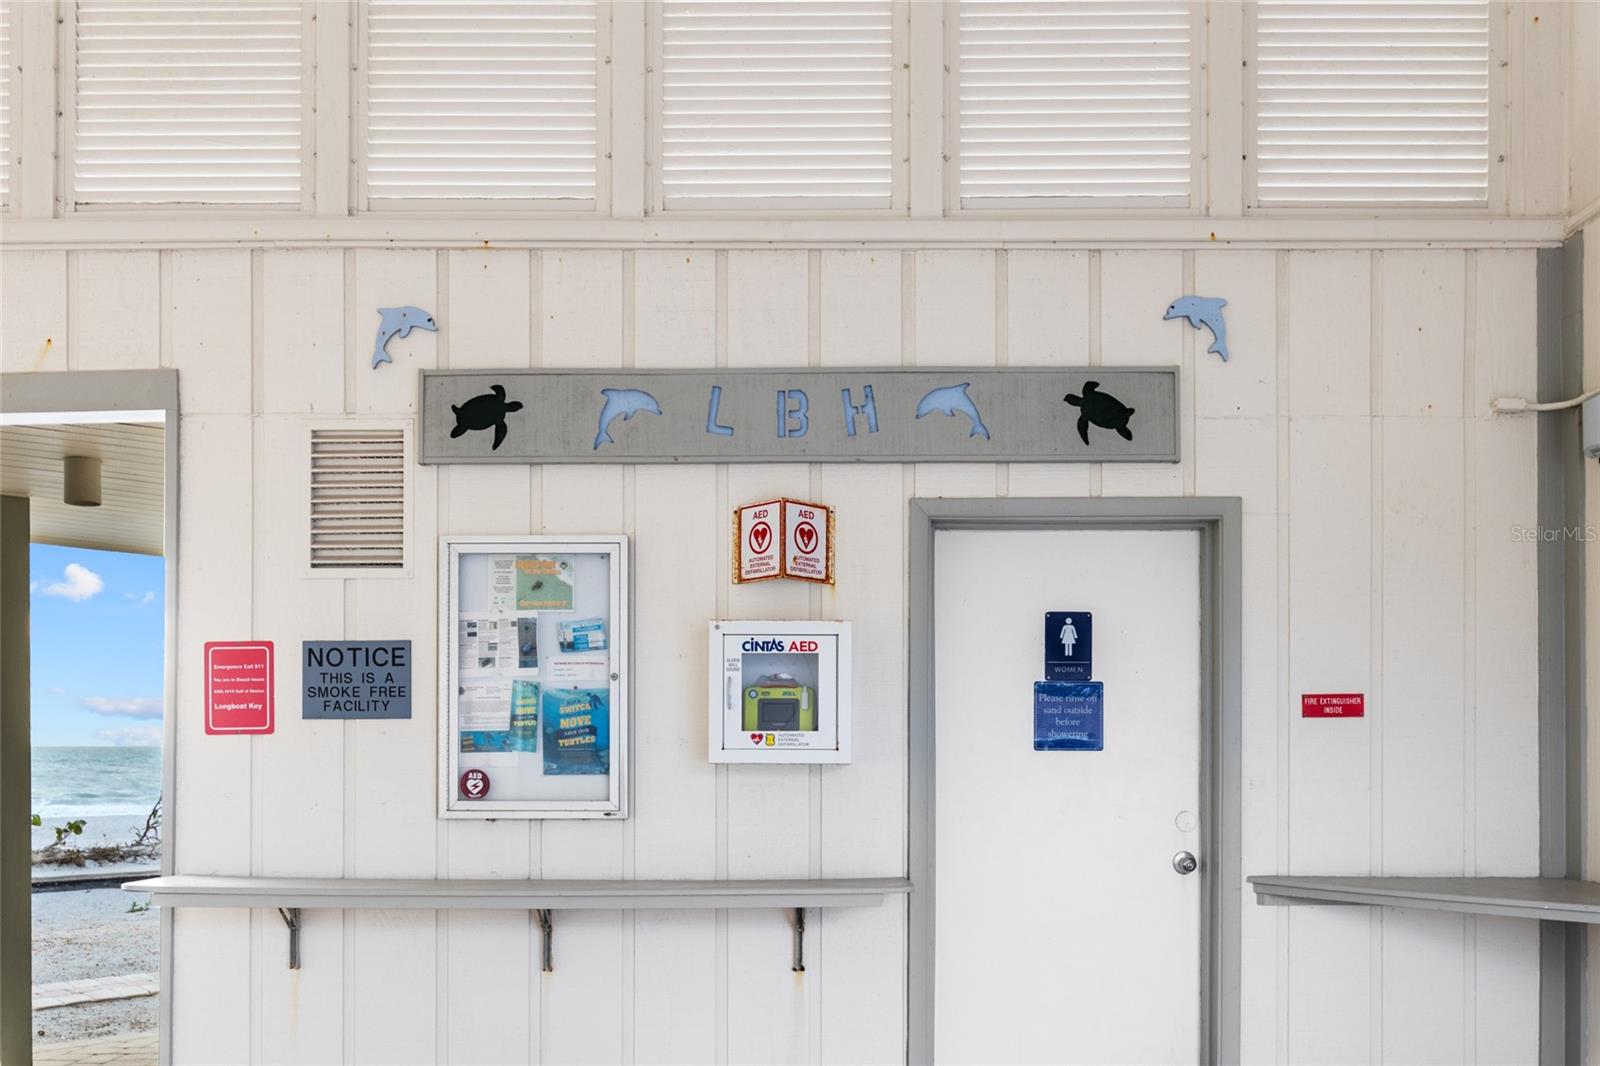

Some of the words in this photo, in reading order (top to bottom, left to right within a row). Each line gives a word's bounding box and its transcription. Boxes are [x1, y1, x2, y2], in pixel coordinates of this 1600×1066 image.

[752, 509, 768, 520] AED
[798, 509, 815, 520] AED
[748, 554, 774, 563] AUTOMATED
[744, 566, 776, 576] DEFIBRILLATOR
[790, 566, 822, 576] DEFIBRILLATOR
[788, 641, 818, 652] AED
[308, 647, 406, 668] NOTICE
[320, 672, 353, 684] THIS
[362, 672, 375, 684] IS
[384, 672, 394, 684] A
[308, 686, 360, 698] SMOKE
[370, 686, 406, 698] FREE
[1039, 693, 1063, 702] Please
[1065, 694, 1084, 702] rinse
[323, 700, 390, 712] FACILITY
[1043, 705, 1062, 714] sand
[1064, 704, 1093, 714] outside
[560, 715, 592, 728] MOVE
[1056, 717, 1081, 726] before
[1047, 729, 1088, 740] showering
[558, 735, 596, 747] TURTLES
